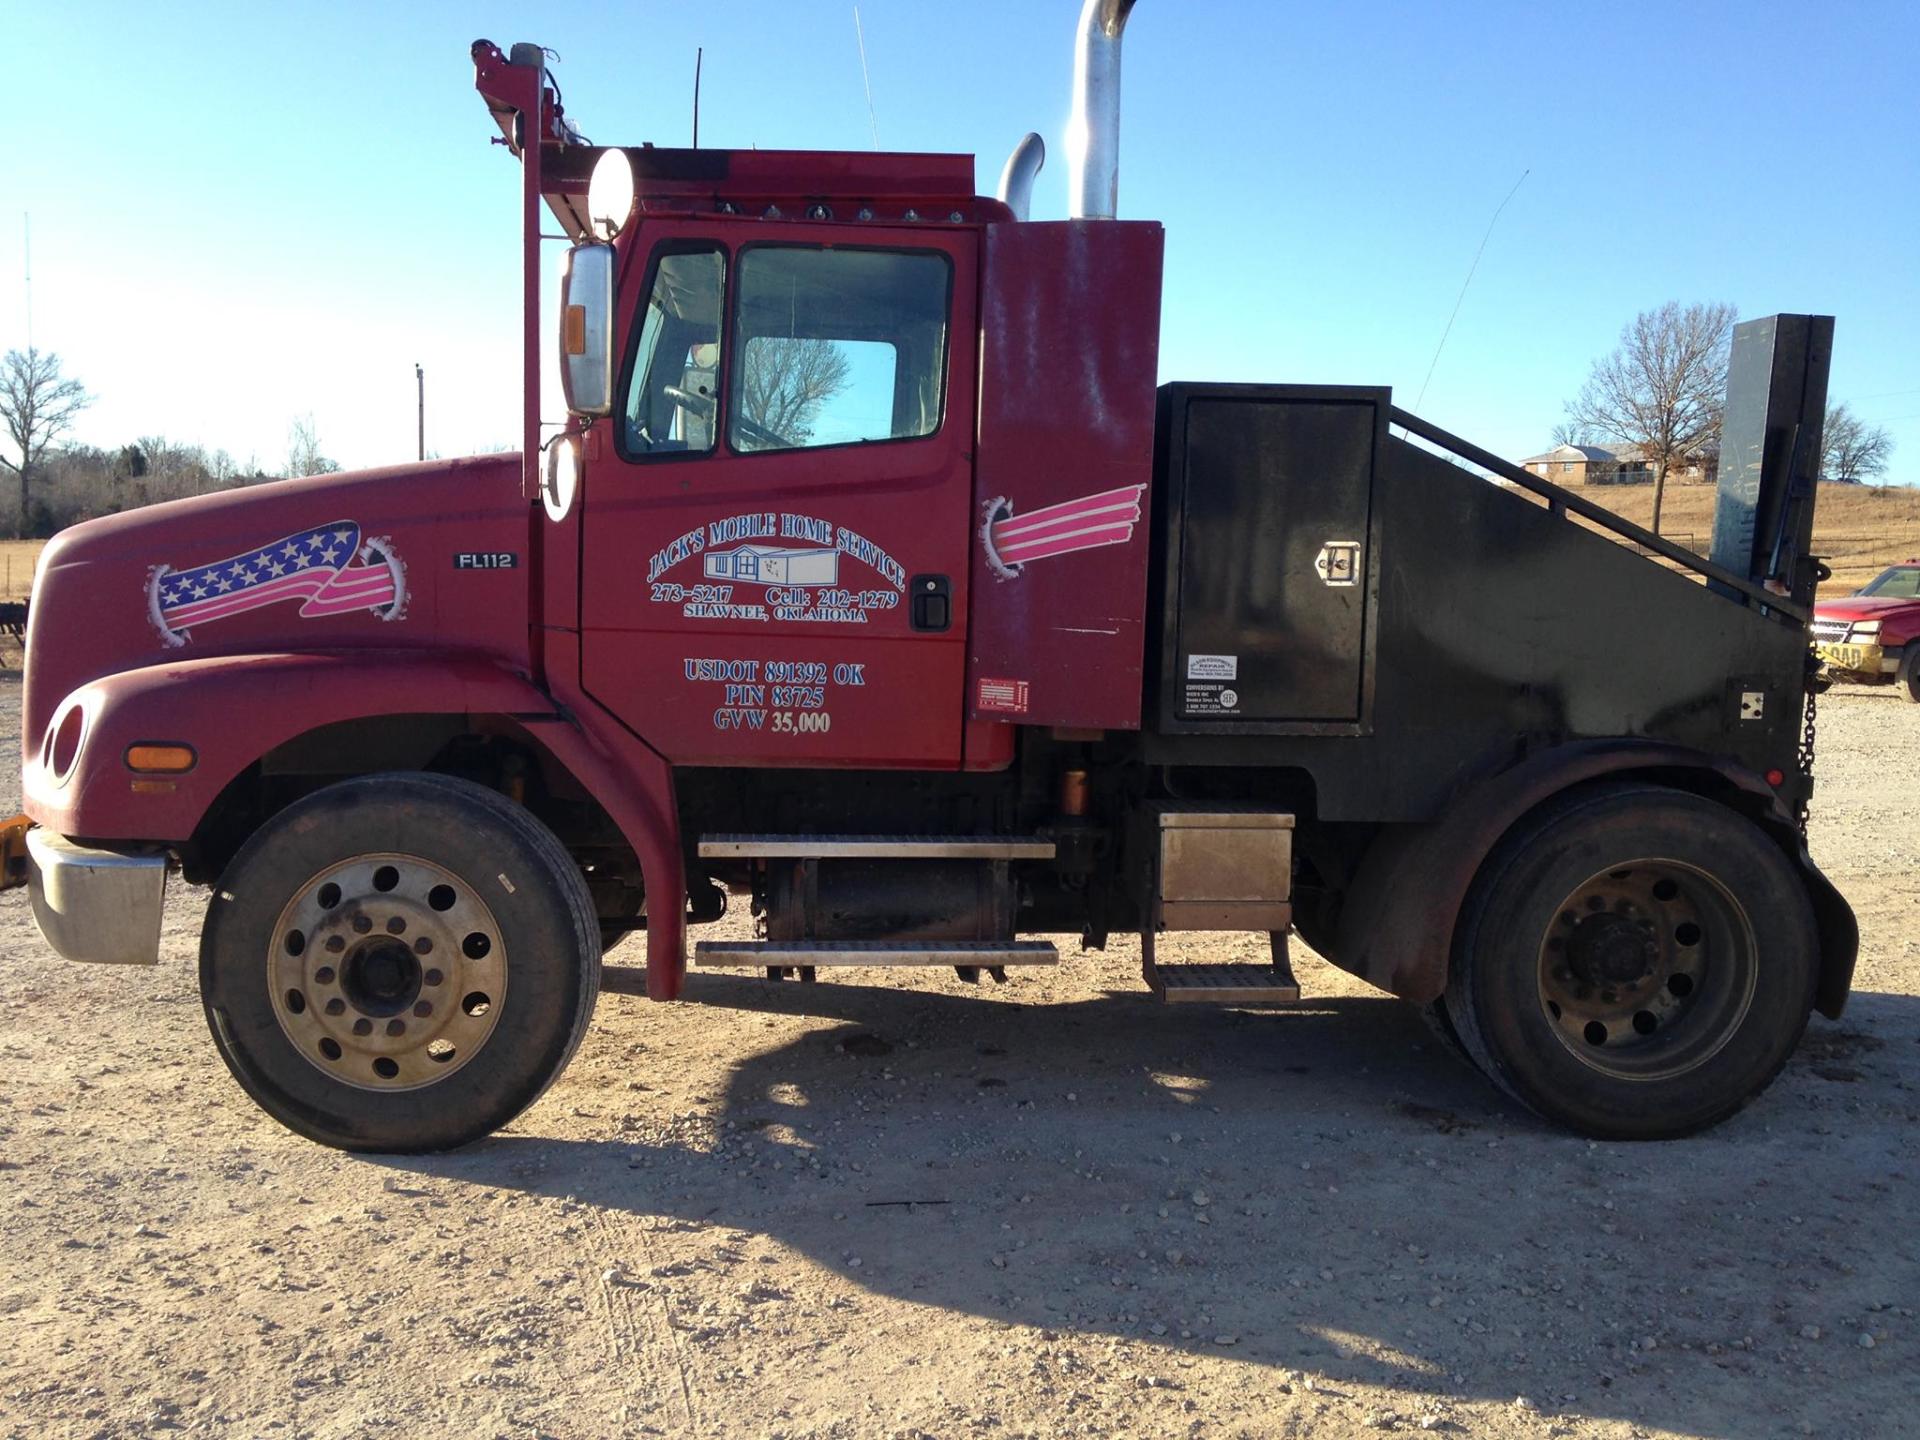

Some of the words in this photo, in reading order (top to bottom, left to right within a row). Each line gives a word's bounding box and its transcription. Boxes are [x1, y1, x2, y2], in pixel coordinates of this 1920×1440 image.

[459, 553, 512, 568] FL112
[647, 527, 705, 583] JACK'S
[709, 513, 775, 547] MOBILE
[781, 513, 833, 546] HOME
[836, 527, 906, 592] SERVICE
[651, 584, 733, 604] 273-5217
[765, 586, 811, 606] Cell:
[817, 589, 899, 609] 202-1279
[683, 603, 769, 622] SHAWNEE,
[773, 604, 868, 623] OKLAHOMA
[684, 658, 759, 682] USDOT
[764, 662, 827, 684] 891392
[833, 663, 866, 686] OK
[725, 684, 765, 706] PIN
[771, 686, 825, 708] 83725
[713, 708, 767, 731] GVW
[771, 712, 831, 736] 35,000
